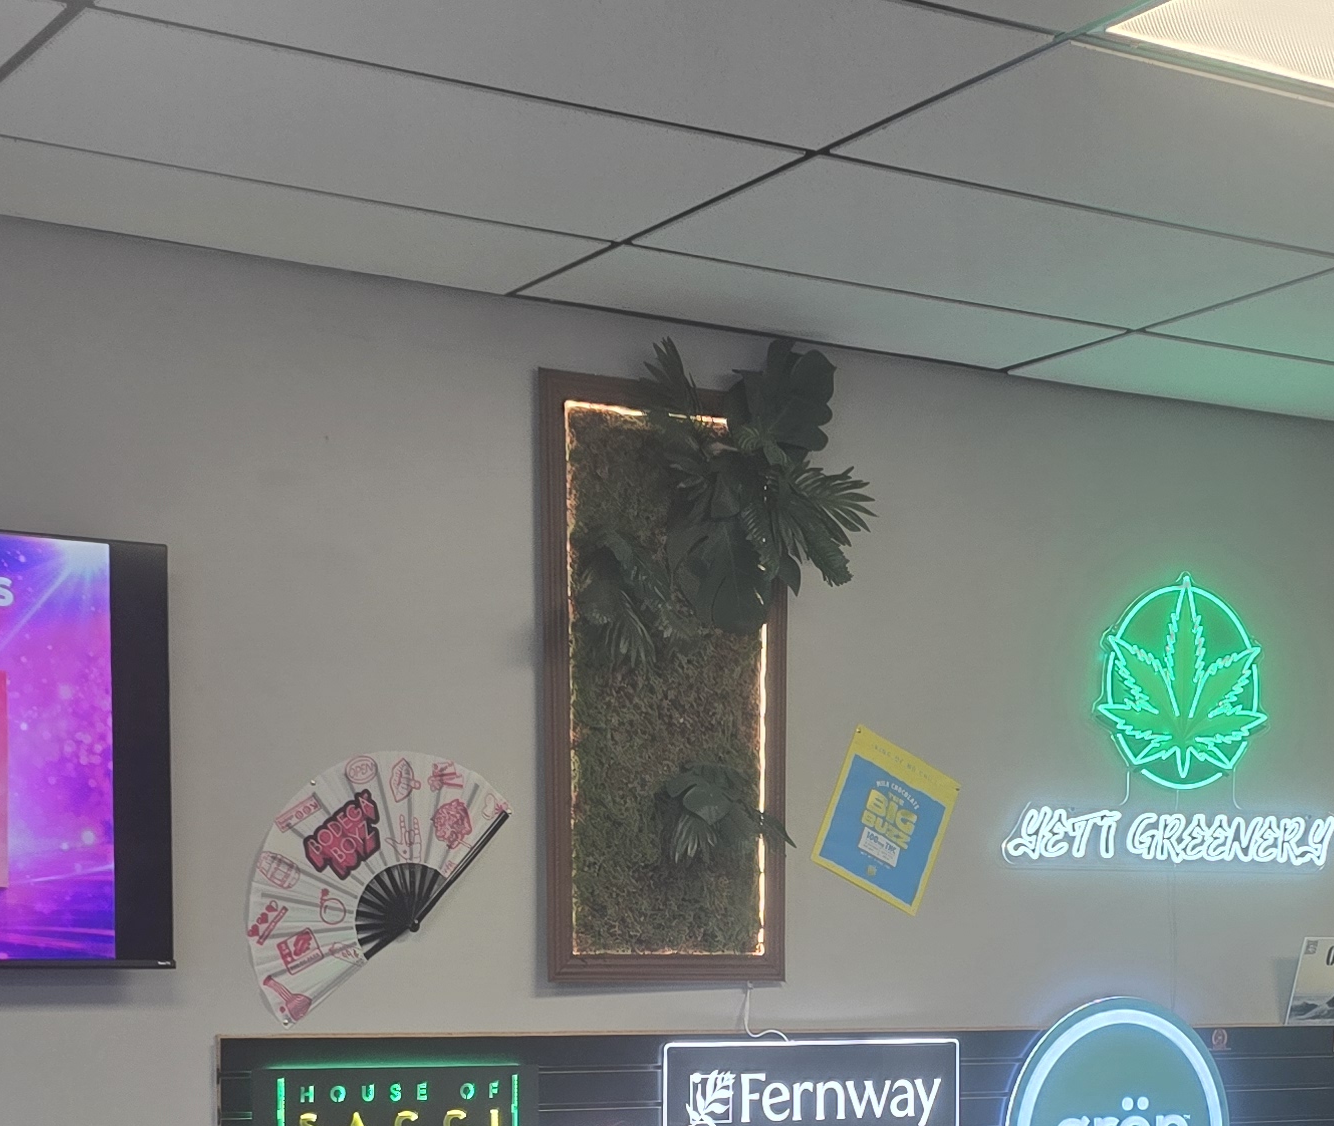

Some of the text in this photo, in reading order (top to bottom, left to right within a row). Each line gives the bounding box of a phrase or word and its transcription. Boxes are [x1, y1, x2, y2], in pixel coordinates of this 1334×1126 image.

[307, 796, 374, 856] BODEGA
[861, 809, 911, 850] BUZZ
[866, 788, 917, 836] BIG
[1005, 805, 1121, 860] YETI
[332, 822, 377, 864] BOYZ
[300, 1080, 499, 1103] HOUSE OF
